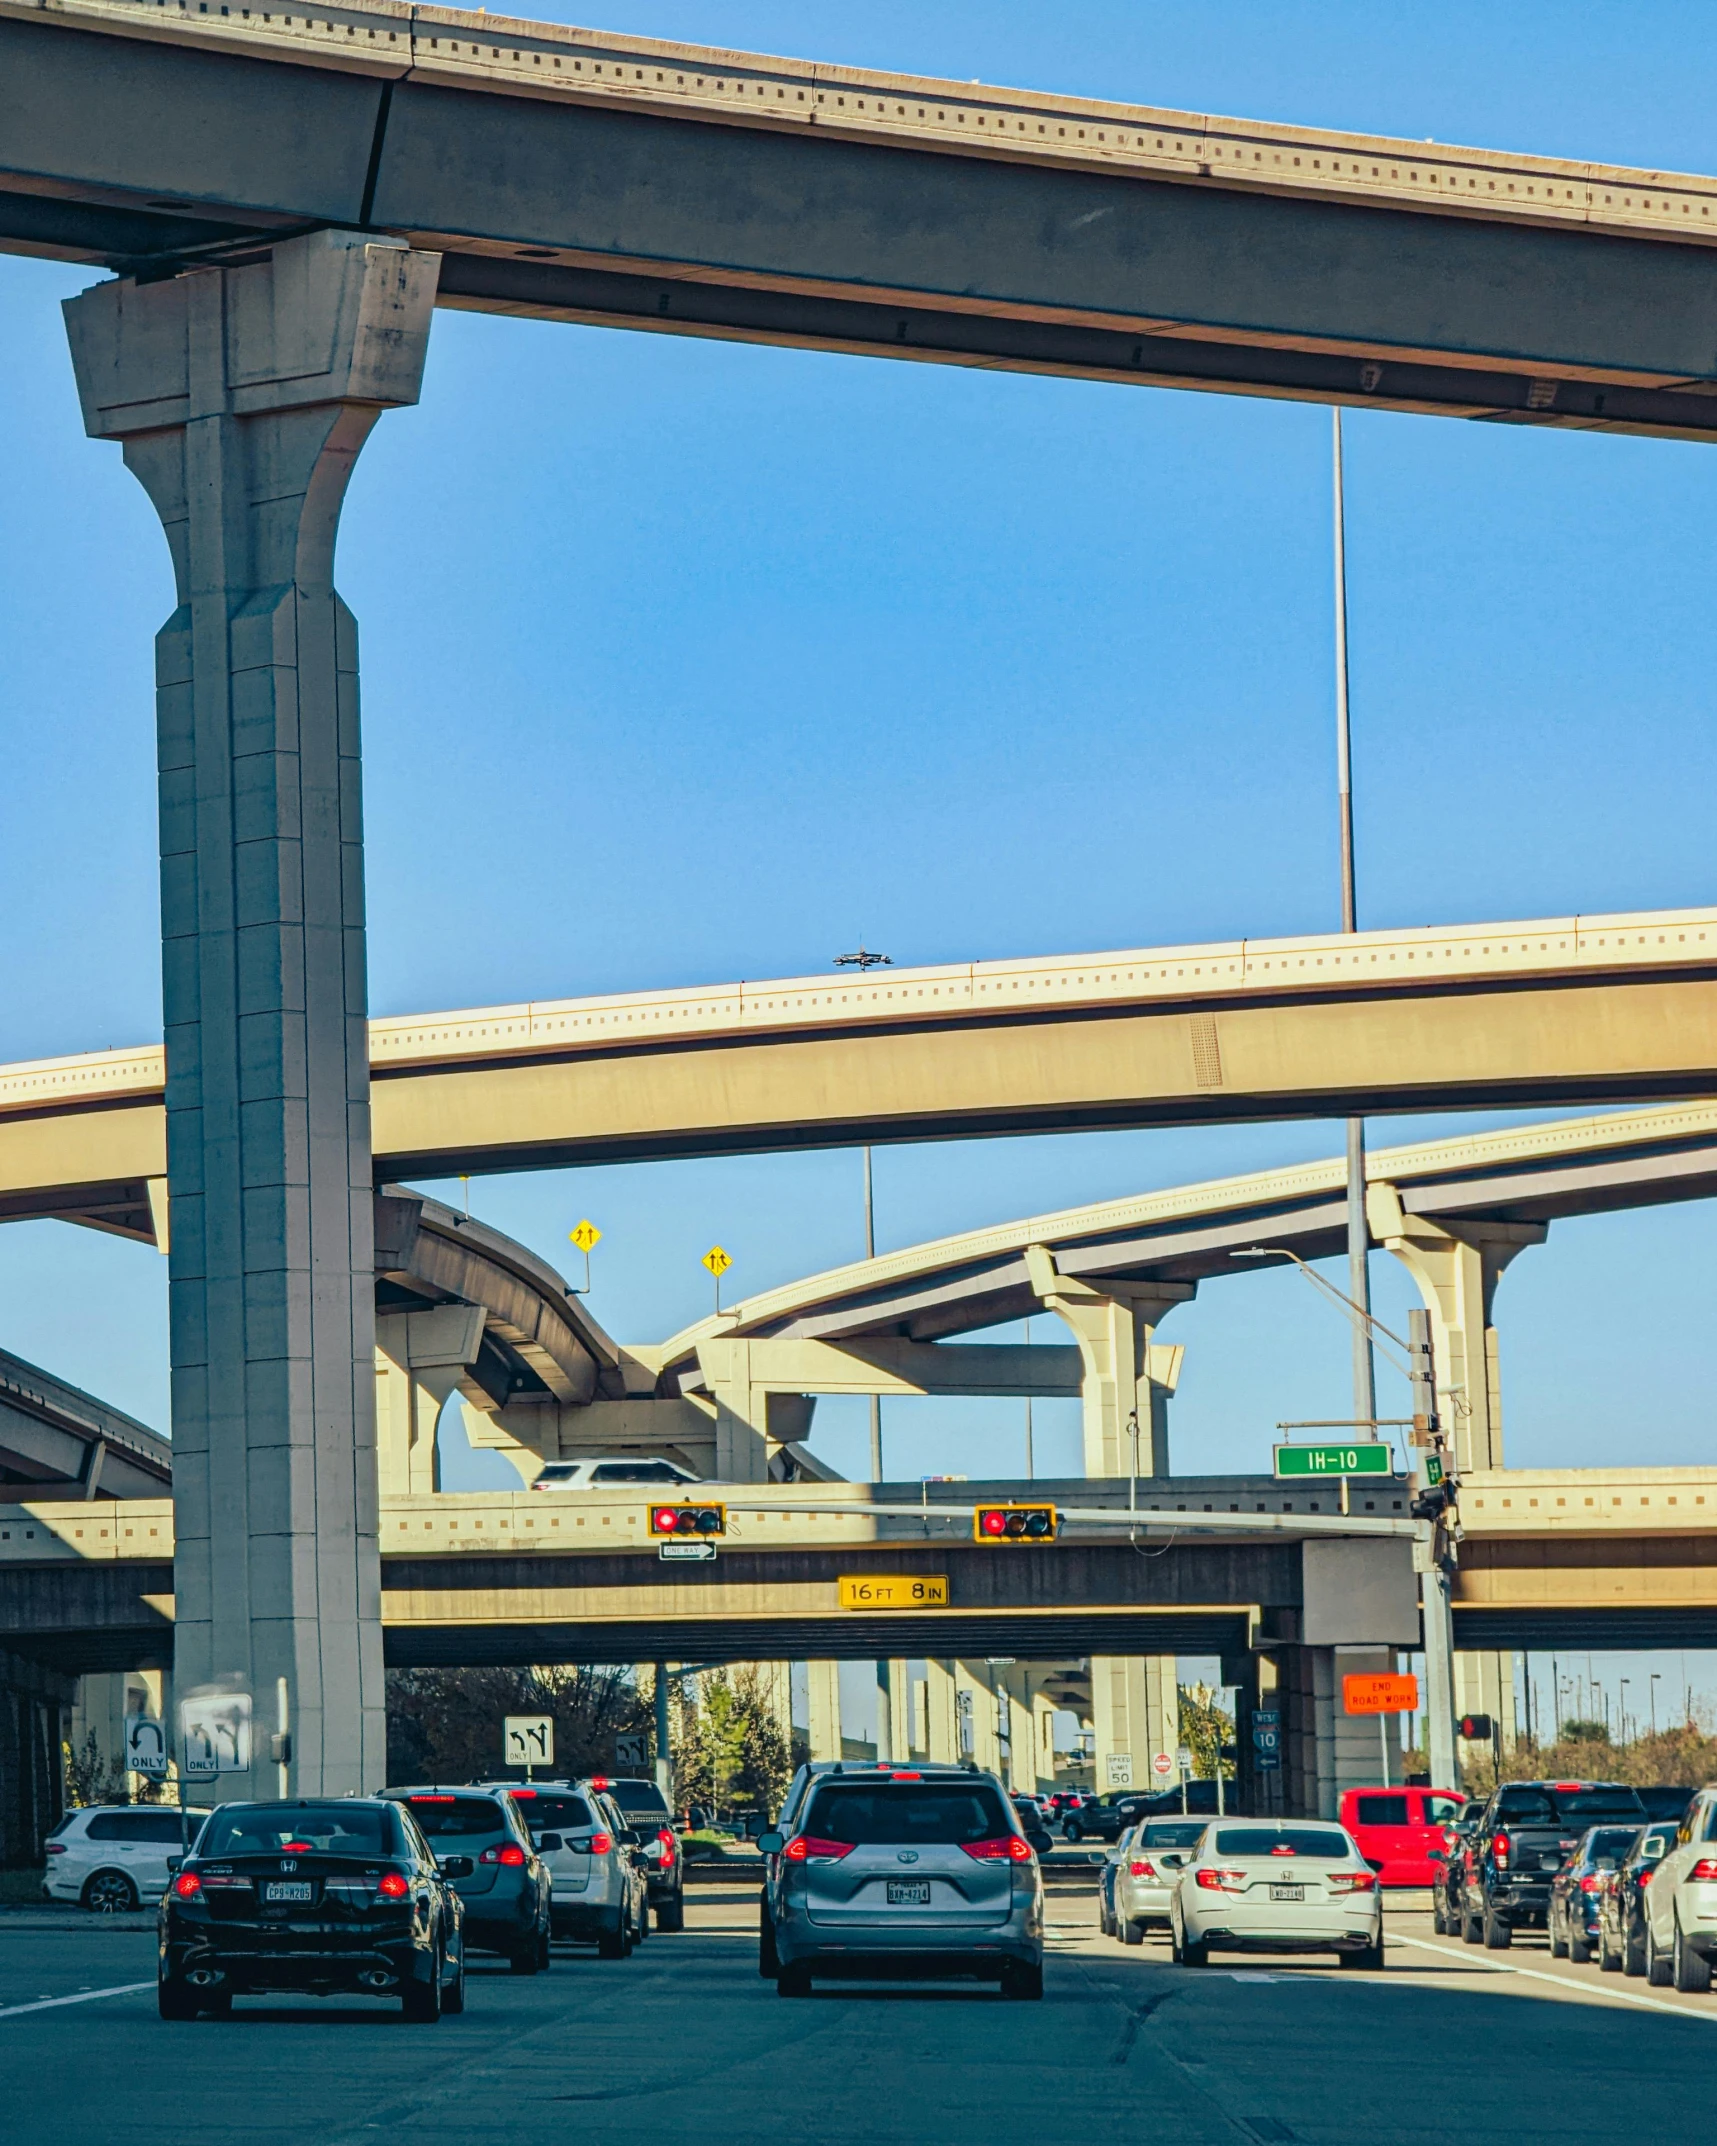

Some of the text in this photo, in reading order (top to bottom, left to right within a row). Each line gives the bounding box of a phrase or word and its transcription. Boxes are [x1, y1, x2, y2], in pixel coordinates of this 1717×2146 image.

[1309, 1451, 1358, 1470] IH-10
[666, 1547, 681, 1555] ONE
[851, 1583, 942, 1600] 16 FT 8 IN
[1372, 1682, 1391, 1692] END
[1352, 1694, 1412, 1706] ROAD WORK
[1260, 1733, 1276, 1747] 10
[510, 1752, 527, 1760] ONLY
[132, 1757, 164, 1768] ONLY
[189, 1761, 215, 1770] ONLY
[1112, 1773, 1130, 1784] 50
